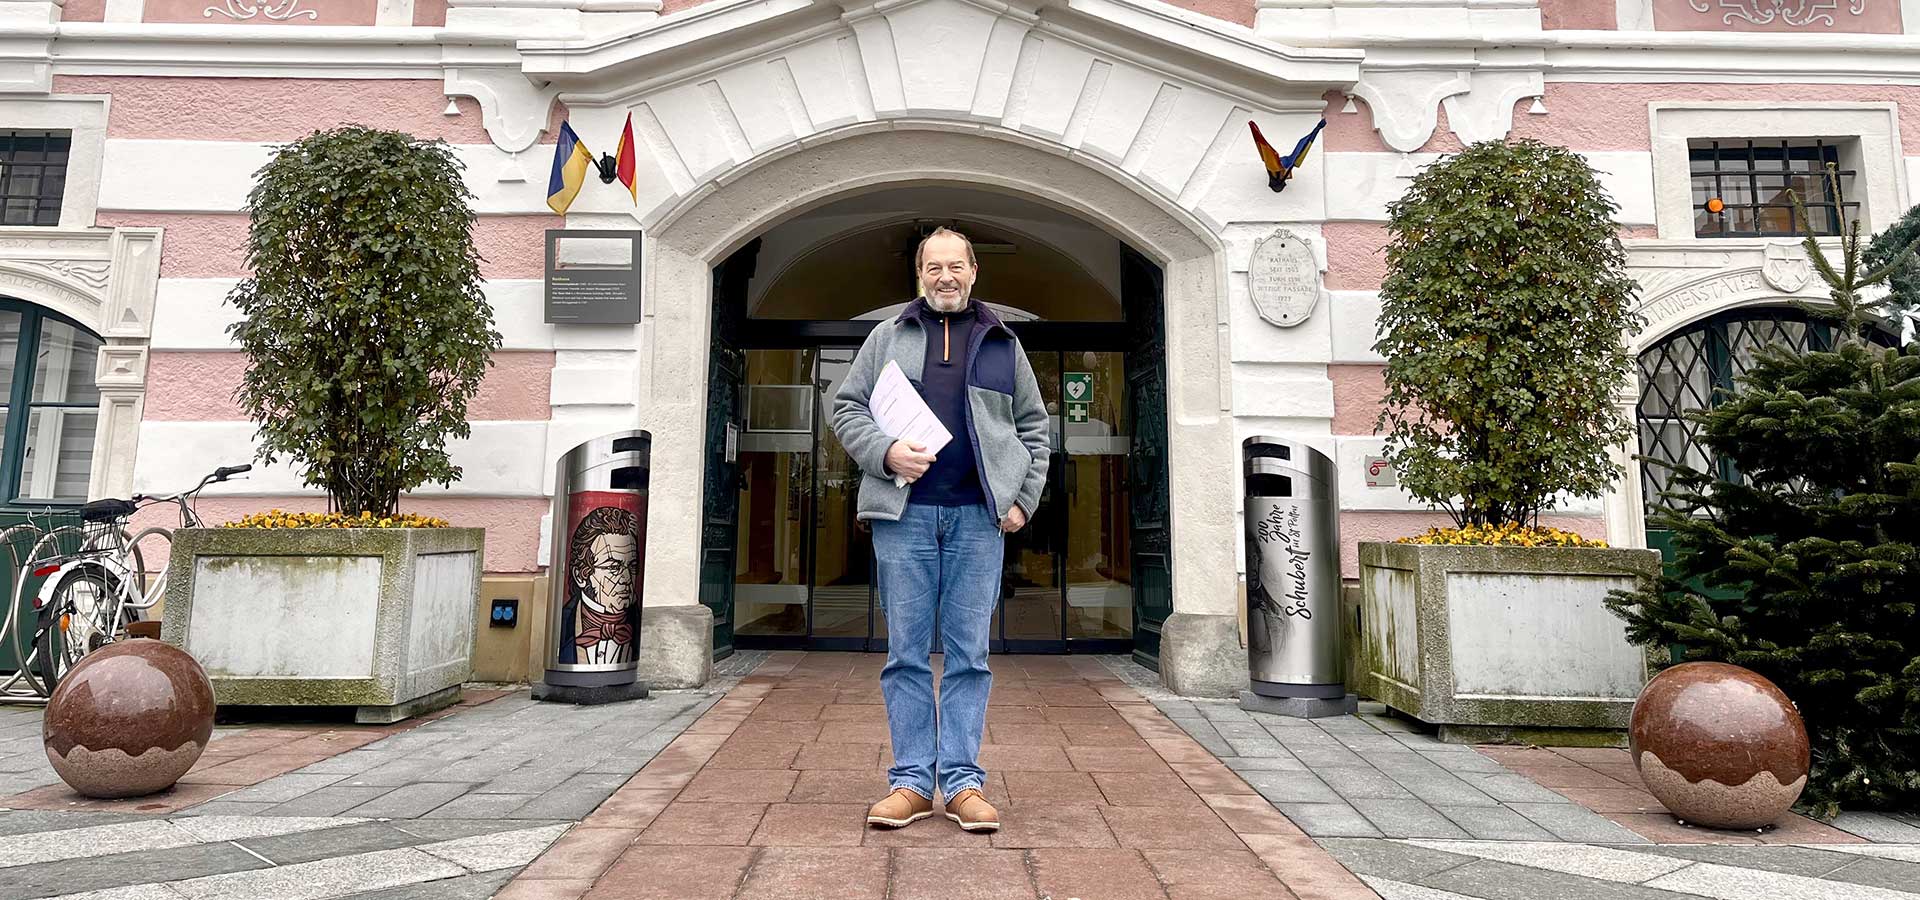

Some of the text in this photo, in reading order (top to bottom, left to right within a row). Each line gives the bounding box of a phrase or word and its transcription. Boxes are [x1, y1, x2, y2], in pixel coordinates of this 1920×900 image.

[1258, 520, 1269, 544] 200
[1266, 504, 1290, 543] Jahre
[1285, 544, 1312, 620] Schubert
